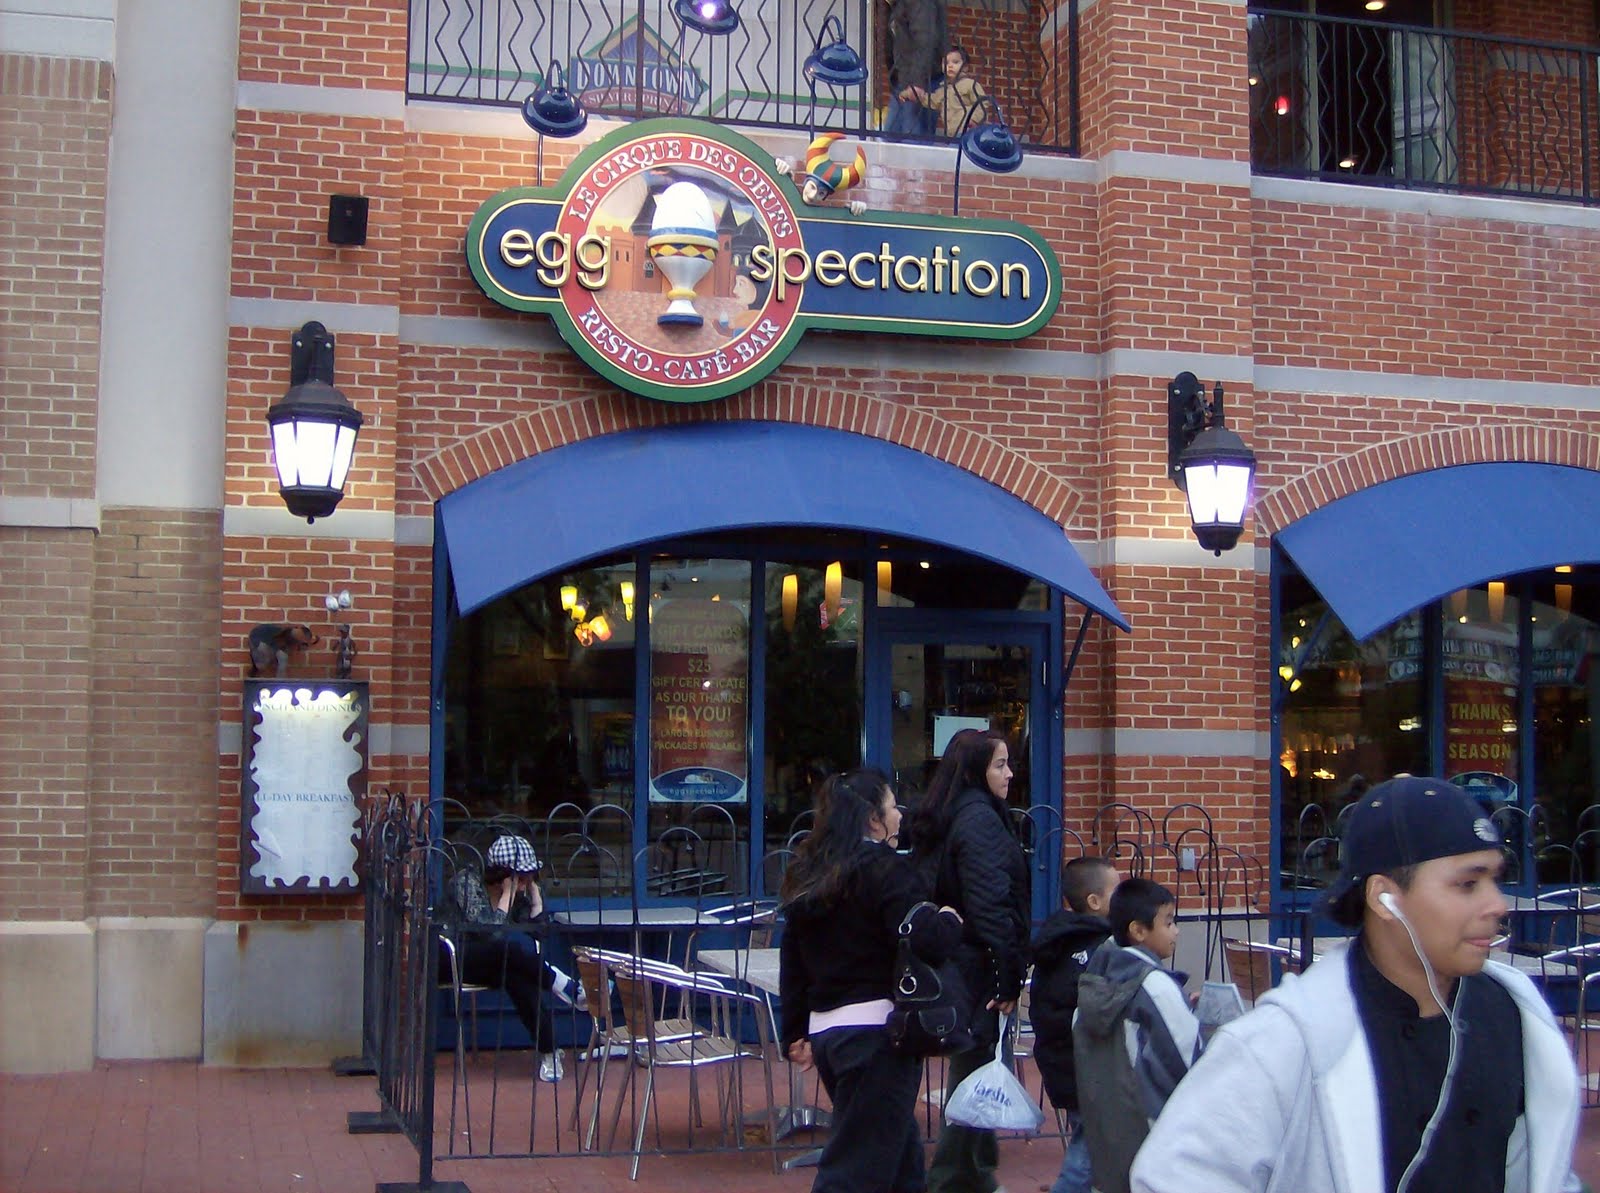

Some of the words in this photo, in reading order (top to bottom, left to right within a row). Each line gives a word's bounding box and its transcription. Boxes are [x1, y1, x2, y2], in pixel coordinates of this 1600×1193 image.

[576, 60, 696, 99] DOWNTOWN
[635, 94, 683, 111] PRIN
[568, 185, 599, 223] LE
[592, 138, 683, 191] CIRQUE
[688, 139, 738, 175] DES
[738, 162, 794, 239] OEUFS
[500, 228, 612, 290] egg
[750, 241, 1031, 302] spectation
[687, 657, 712, 673] $25
[651, 675, 676, 688] GIFT
[678, 676, 746, 689] CERFICATE
[655, 691, 671, 703] AS
[672, 691, 697, 703] OUR
[699, 691, 743, 705] THANKS
[666, 704, 688, 721] TO
[692, 704, 732, 722] YOU!
[1449, 703, 1511, 720] THANKS
[654, 740, 698, 750] PACKAGES
[1448, 742, 1512, 760] SEASON
[256, 792, 292, 802] LL-DAY
